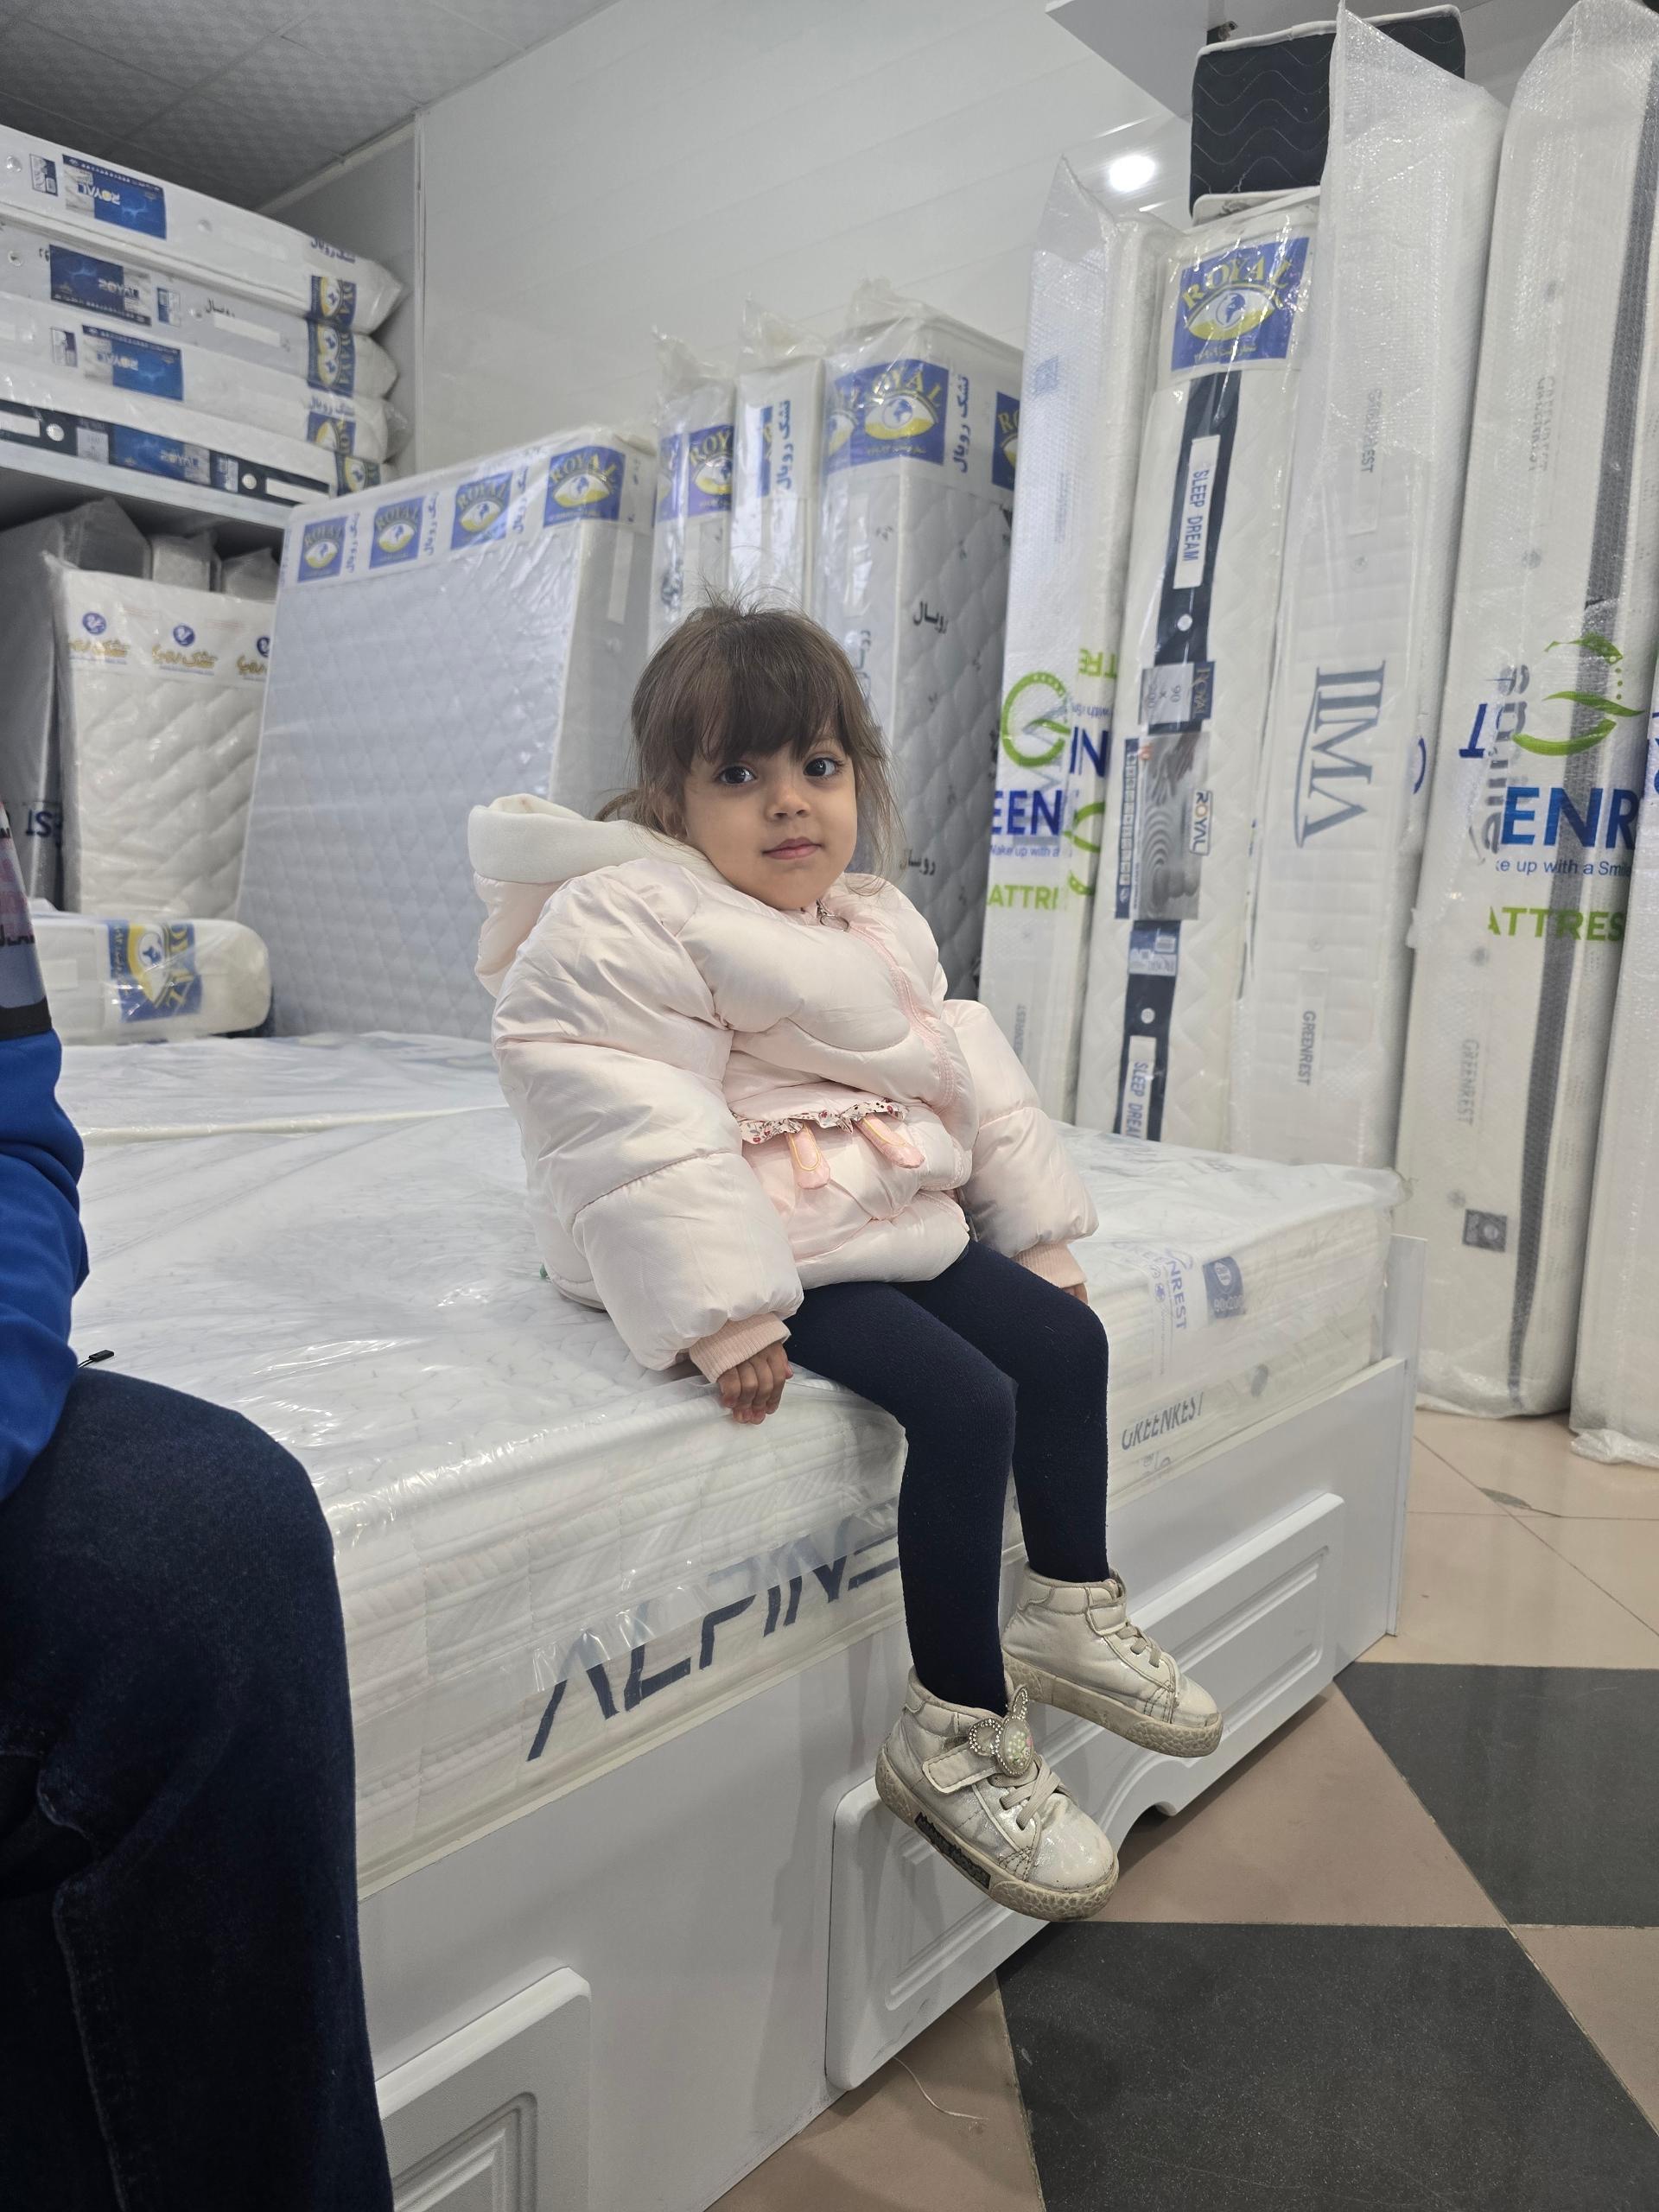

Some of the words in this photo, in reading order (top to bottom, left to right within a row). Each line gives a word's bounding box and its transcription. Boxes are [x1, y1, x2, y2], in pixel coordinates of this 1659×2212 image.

[78, 183, 120, 205] ROYAL
[1182, 257, 1291, 309] ROYAL
[1189, 468, 1210, 508] SLEEP
[1182, 516, 1204, 562] DREAM
[1192, 791, 1210, 854] ROYAL
[1516, 860, 1537, 875] up
[1543, 860, 1578, 874] with
[1583, 863, 1593, 874] a
[1297, 1010, 1317, 1086] GREENREST
[1130, 1061, 1148, 1097] SLEEP
